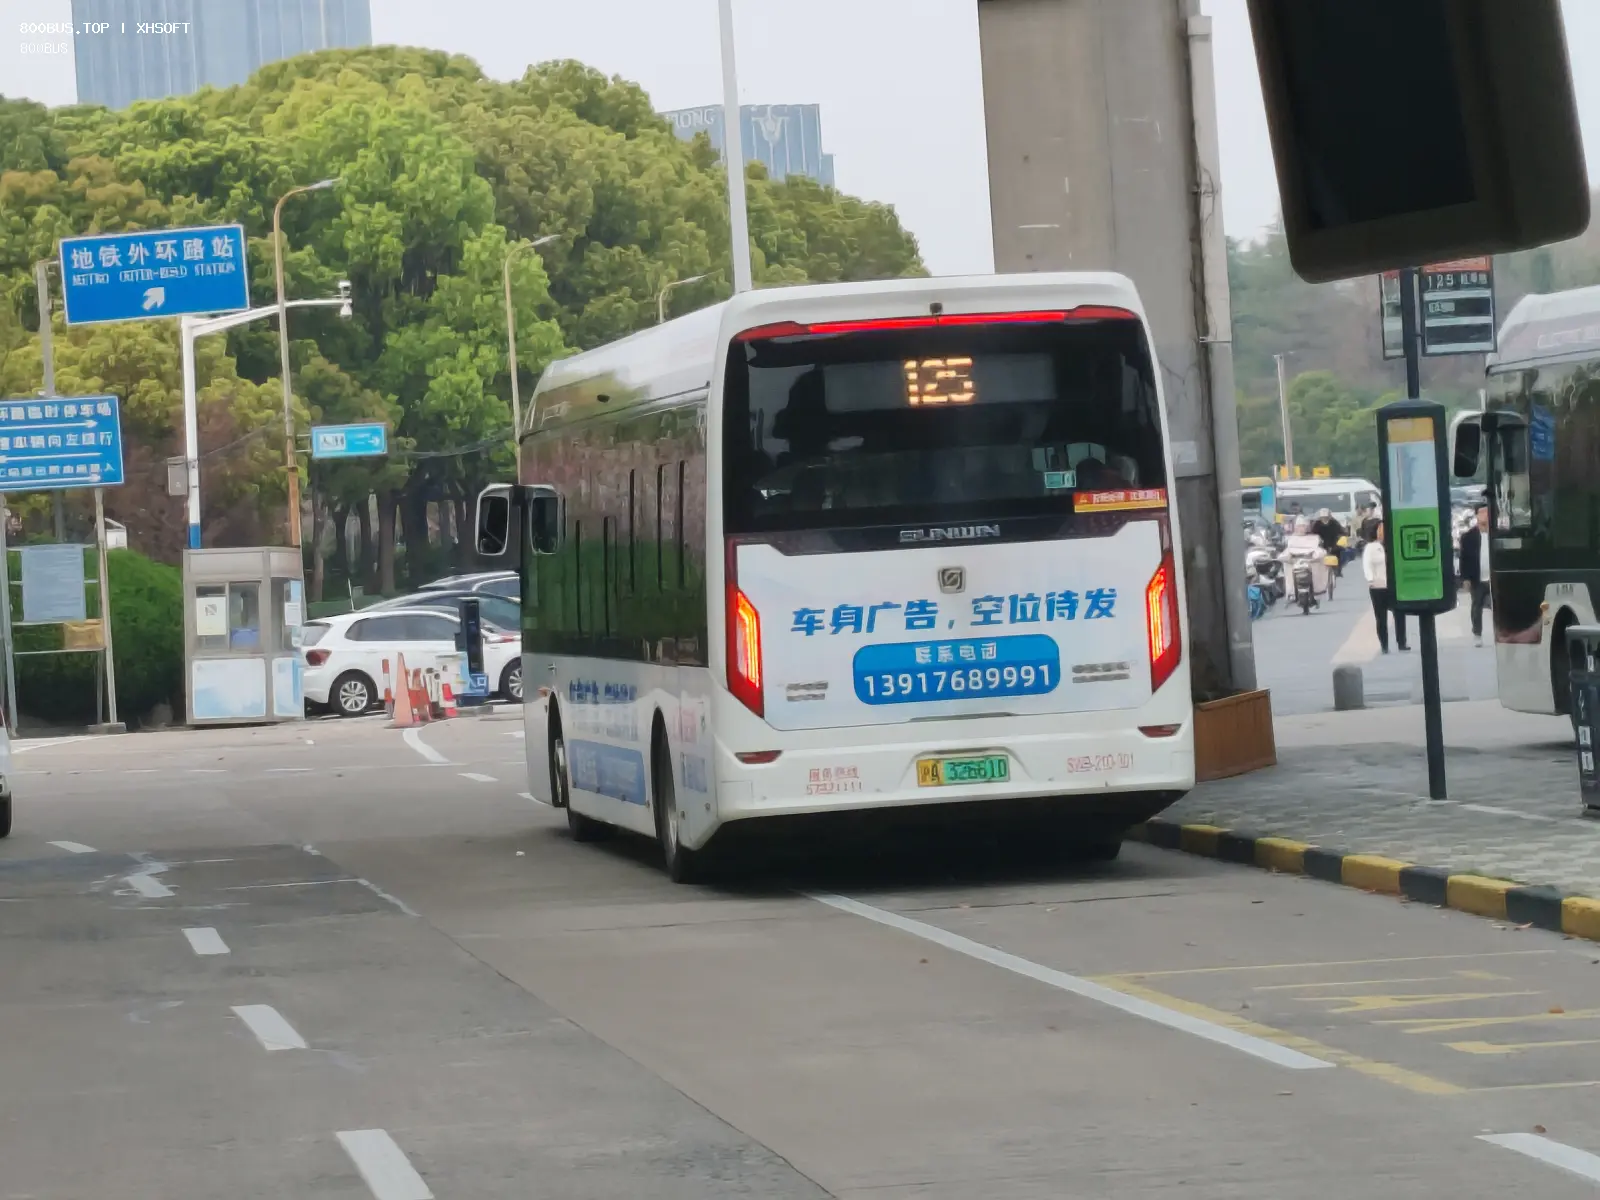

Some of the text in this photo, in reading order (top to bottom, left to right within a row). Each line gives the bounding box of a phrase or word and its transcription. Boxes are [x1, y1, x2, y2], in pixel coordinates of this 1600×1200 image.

[71, 234, 236, 270] 地铁外环路站
[864, 664, 1052, 698] 13917689991
